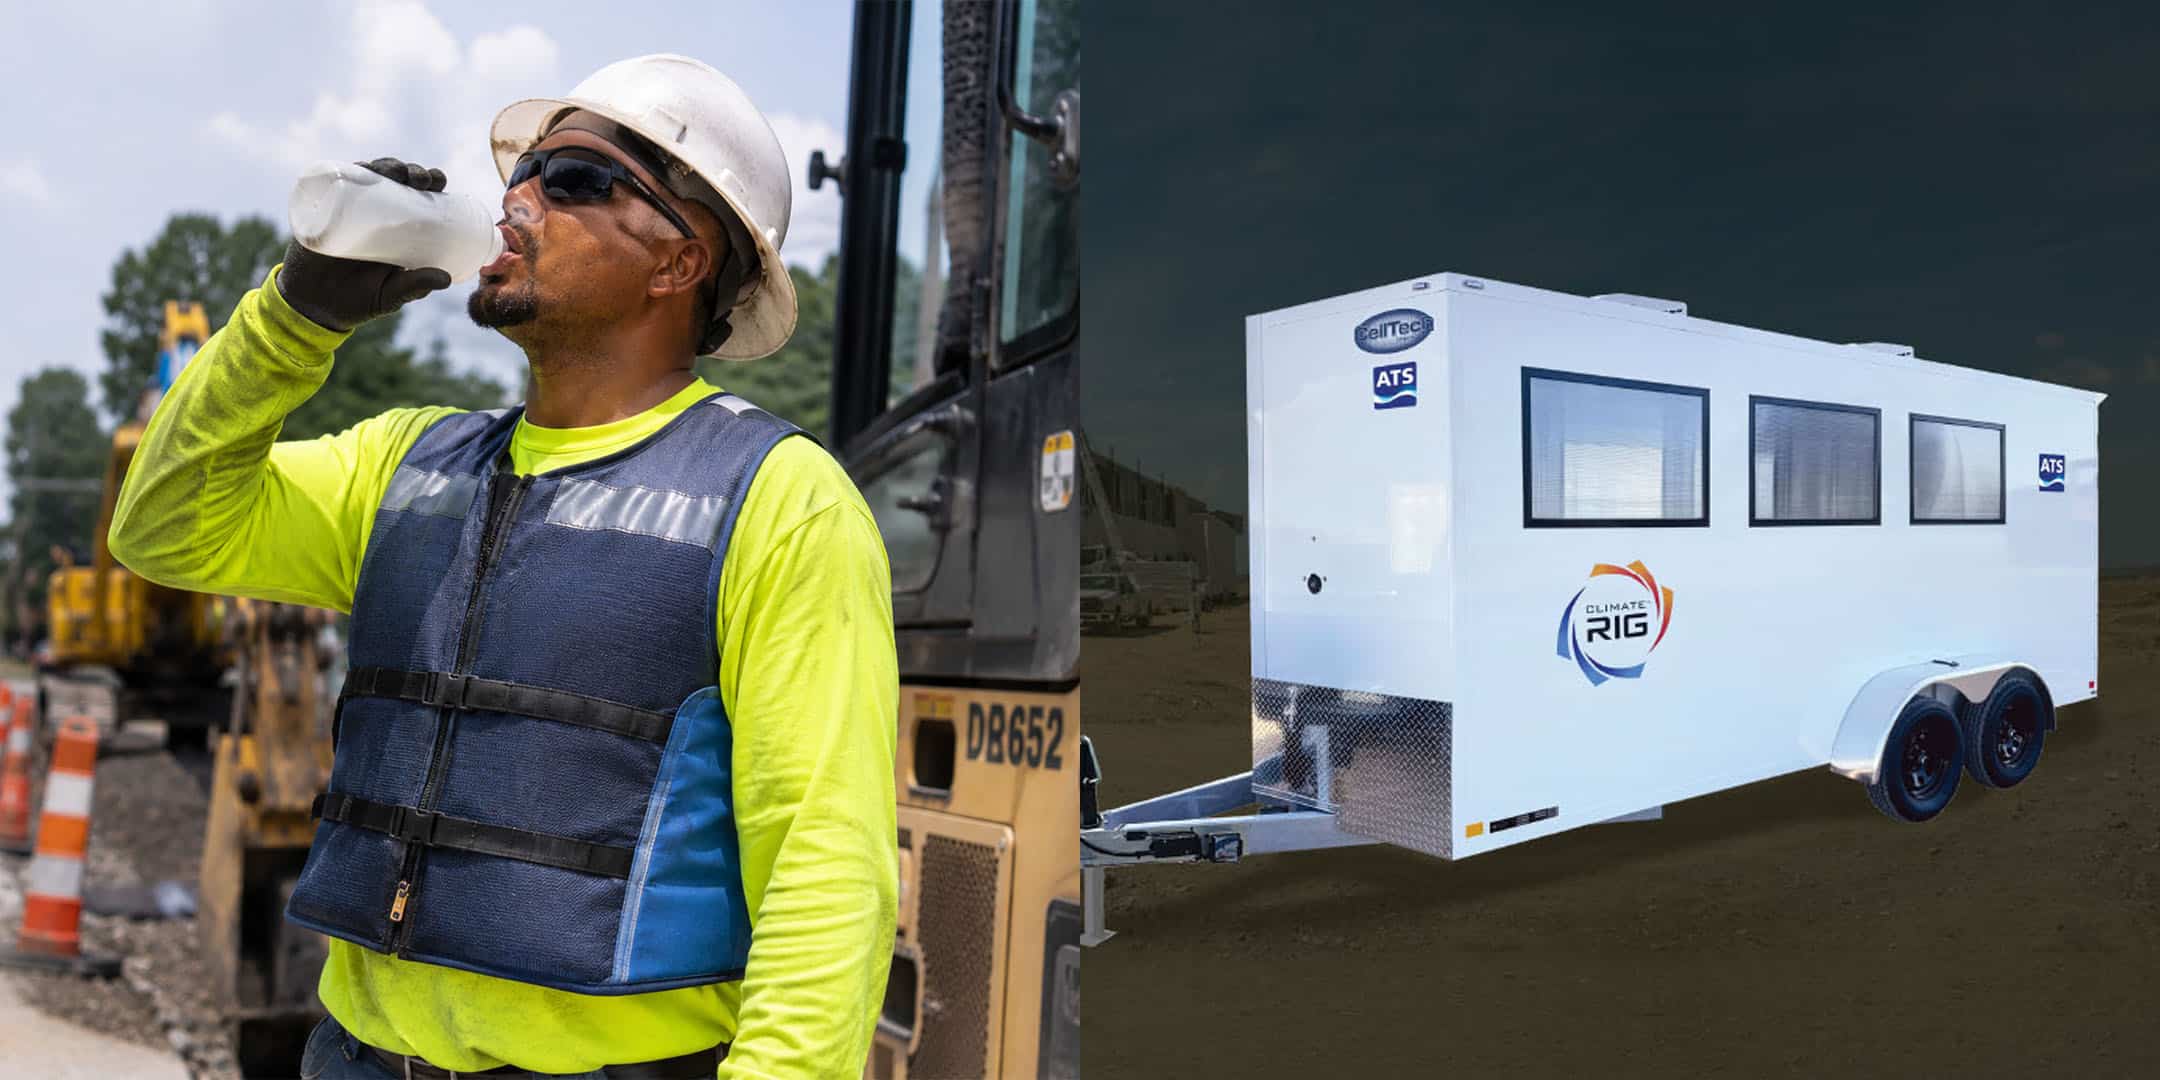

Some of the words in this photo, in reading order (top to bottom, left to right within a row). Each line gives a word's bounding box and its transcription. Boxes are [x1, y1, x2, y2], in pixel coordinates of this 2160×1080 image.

[1376, 367, 1414, 388] ATS
[2040, 458, 2064, 473] ATS
[1586, 600, 1647, 614] CLIMATE
[1587, 612, 1648, 643] RIG
[966, 701, 1064, 770] DB652
